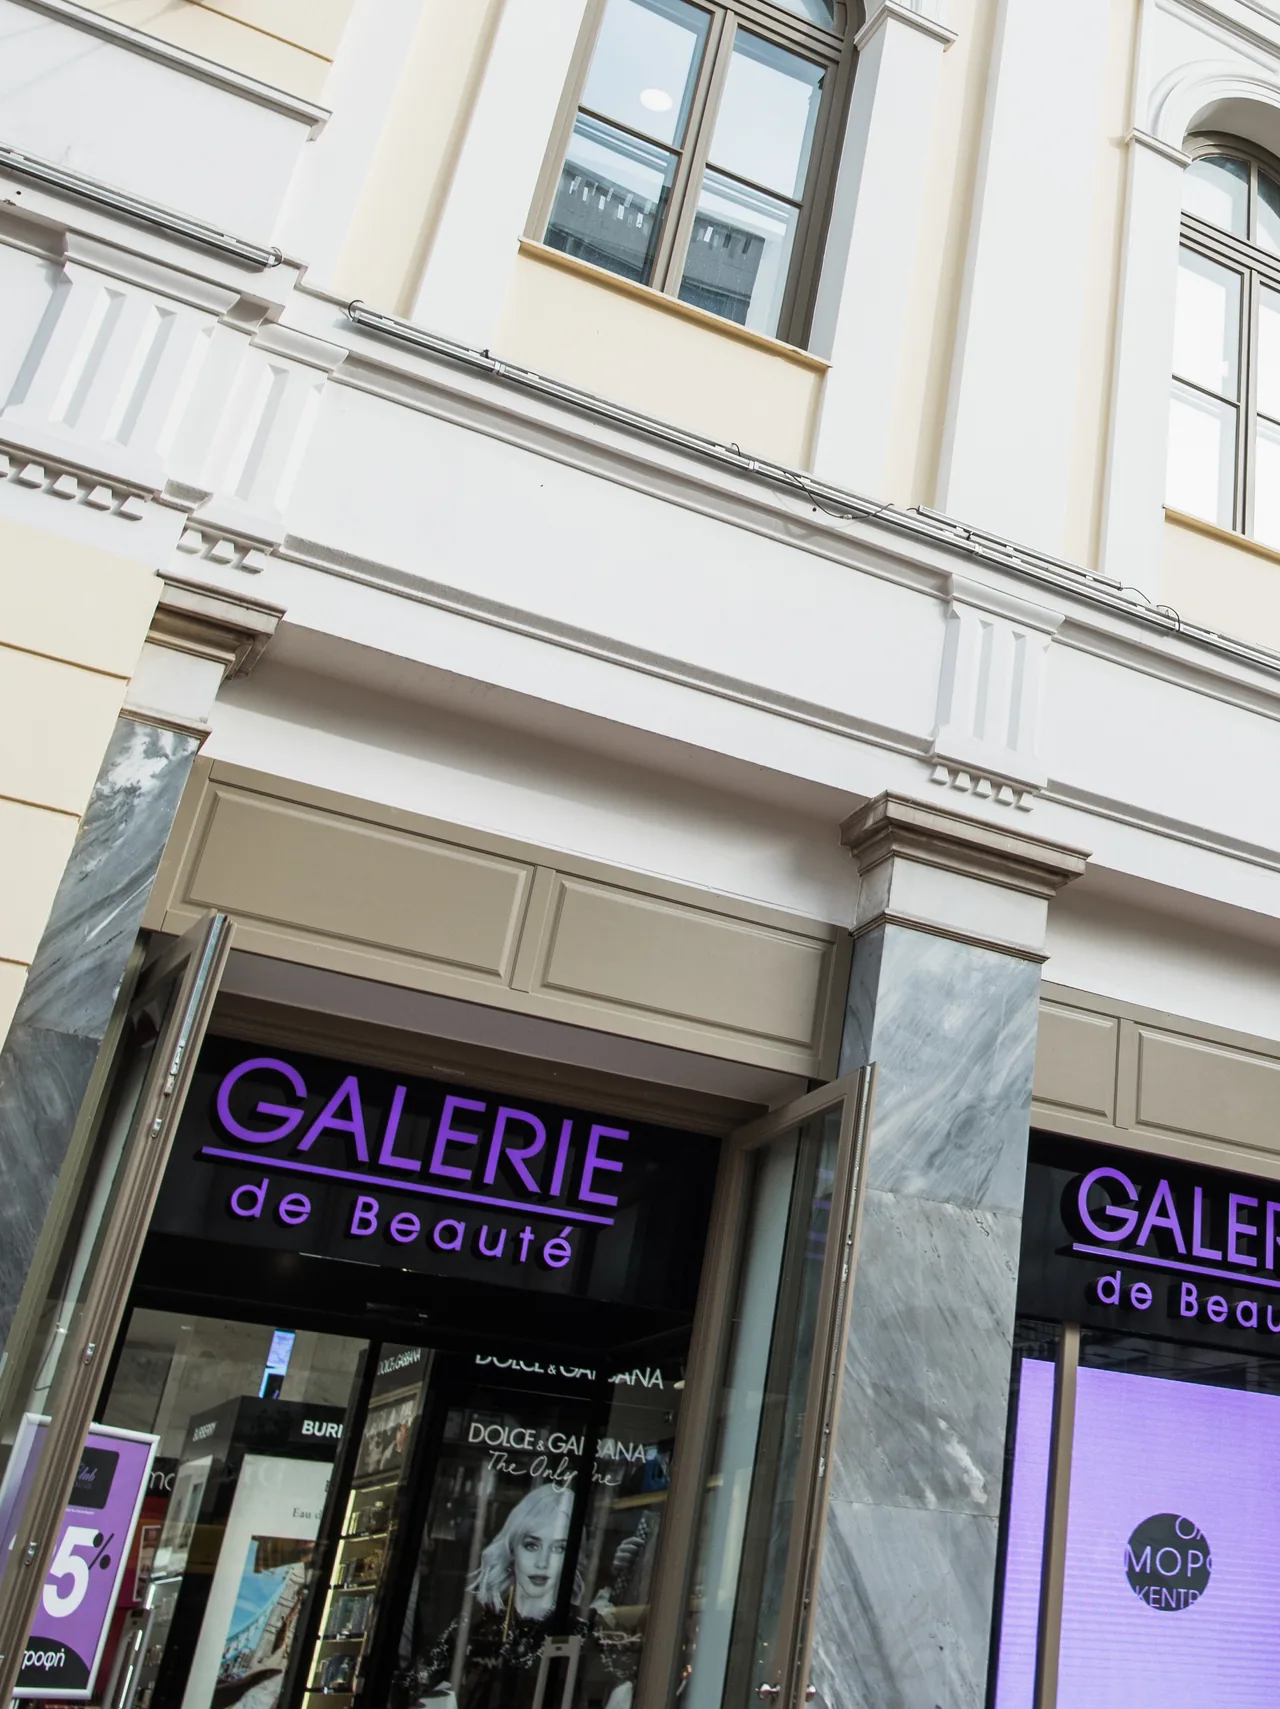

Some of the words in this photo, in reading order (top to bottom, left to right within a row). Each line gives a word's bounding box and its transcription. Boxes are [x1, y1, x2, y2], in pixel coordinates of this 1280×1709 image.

[216, 1057, 630, 1207] GALERIE
[230, 1178, 311, 1225] de
[350, 1196, 574, 1268] Beauté
[1096, 1270, 1153, 1310] de
[467, 1421, 536, 1450] DOLCE
[488, 1450, 528, 1476] The
[529, 1455, 579, 1493] Only
[591, 1461, 622, 1486] ne
